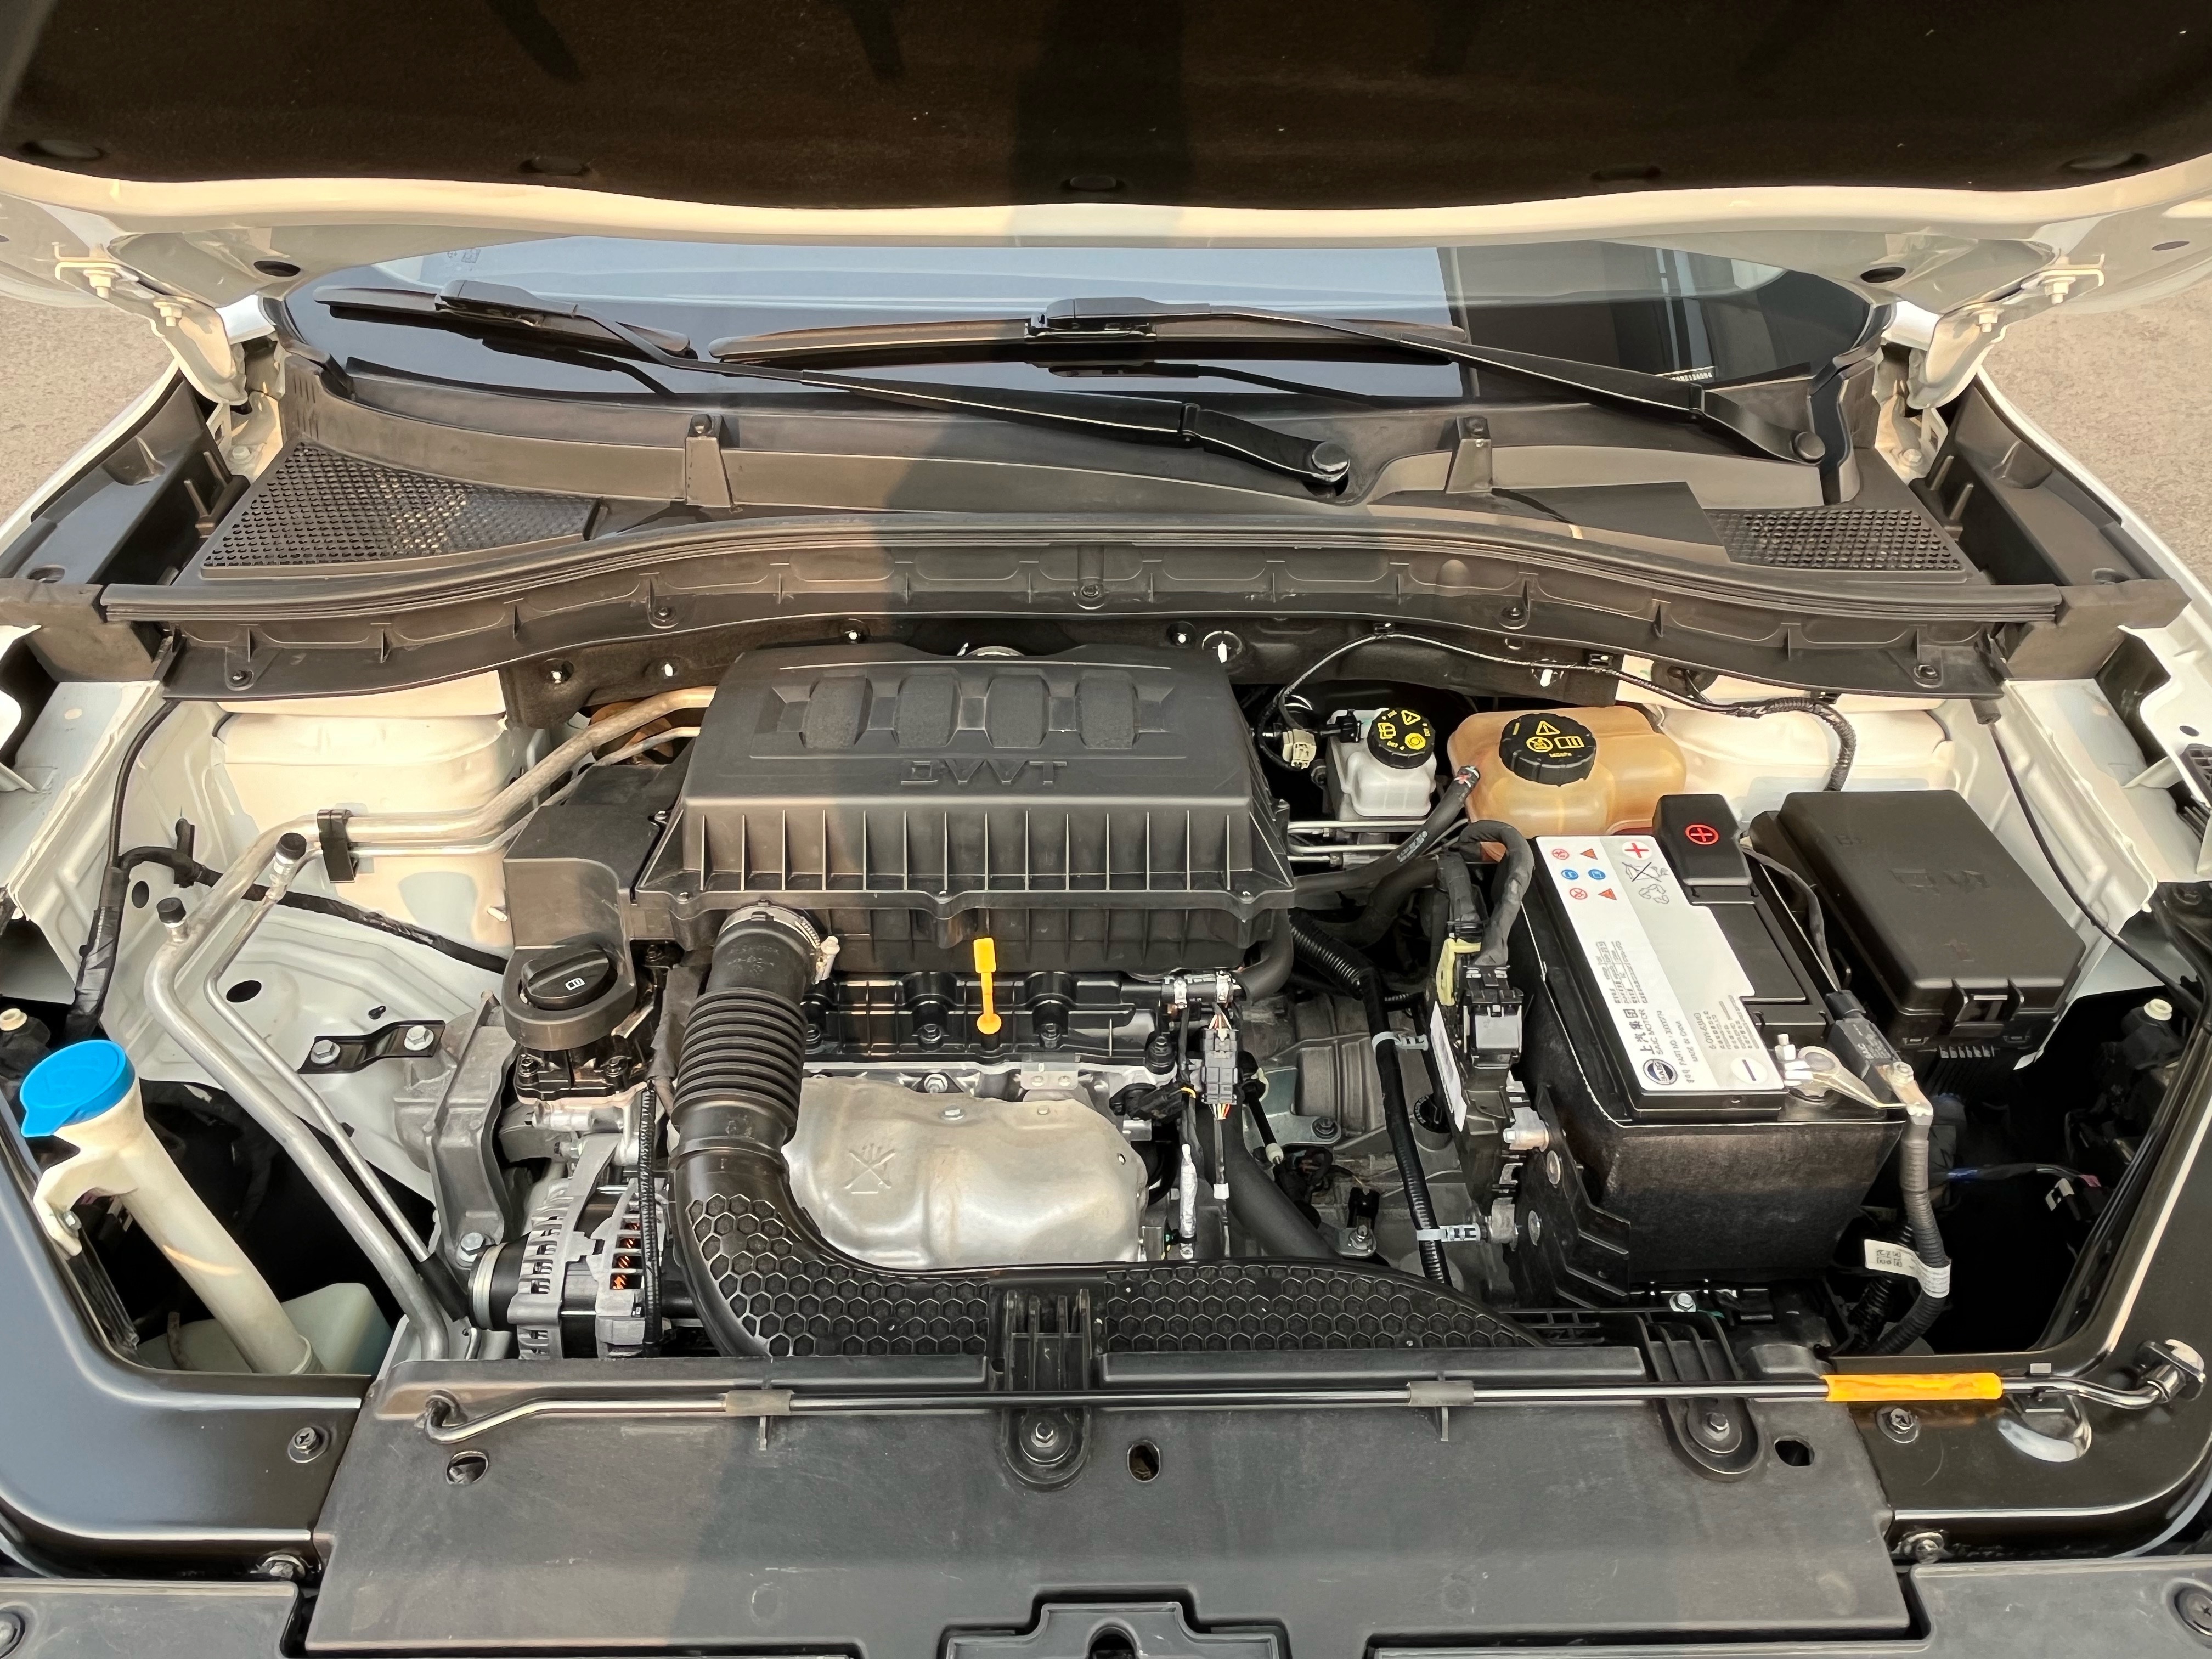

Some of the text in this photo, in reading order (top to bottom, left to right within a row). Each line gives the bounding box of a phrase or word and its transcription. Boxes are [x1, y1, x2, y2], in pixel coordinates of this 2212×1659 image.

[1623, 1008, 1655, 1055] 上汽集团
[1638, 1009, 1655, 1036] MOTOR
